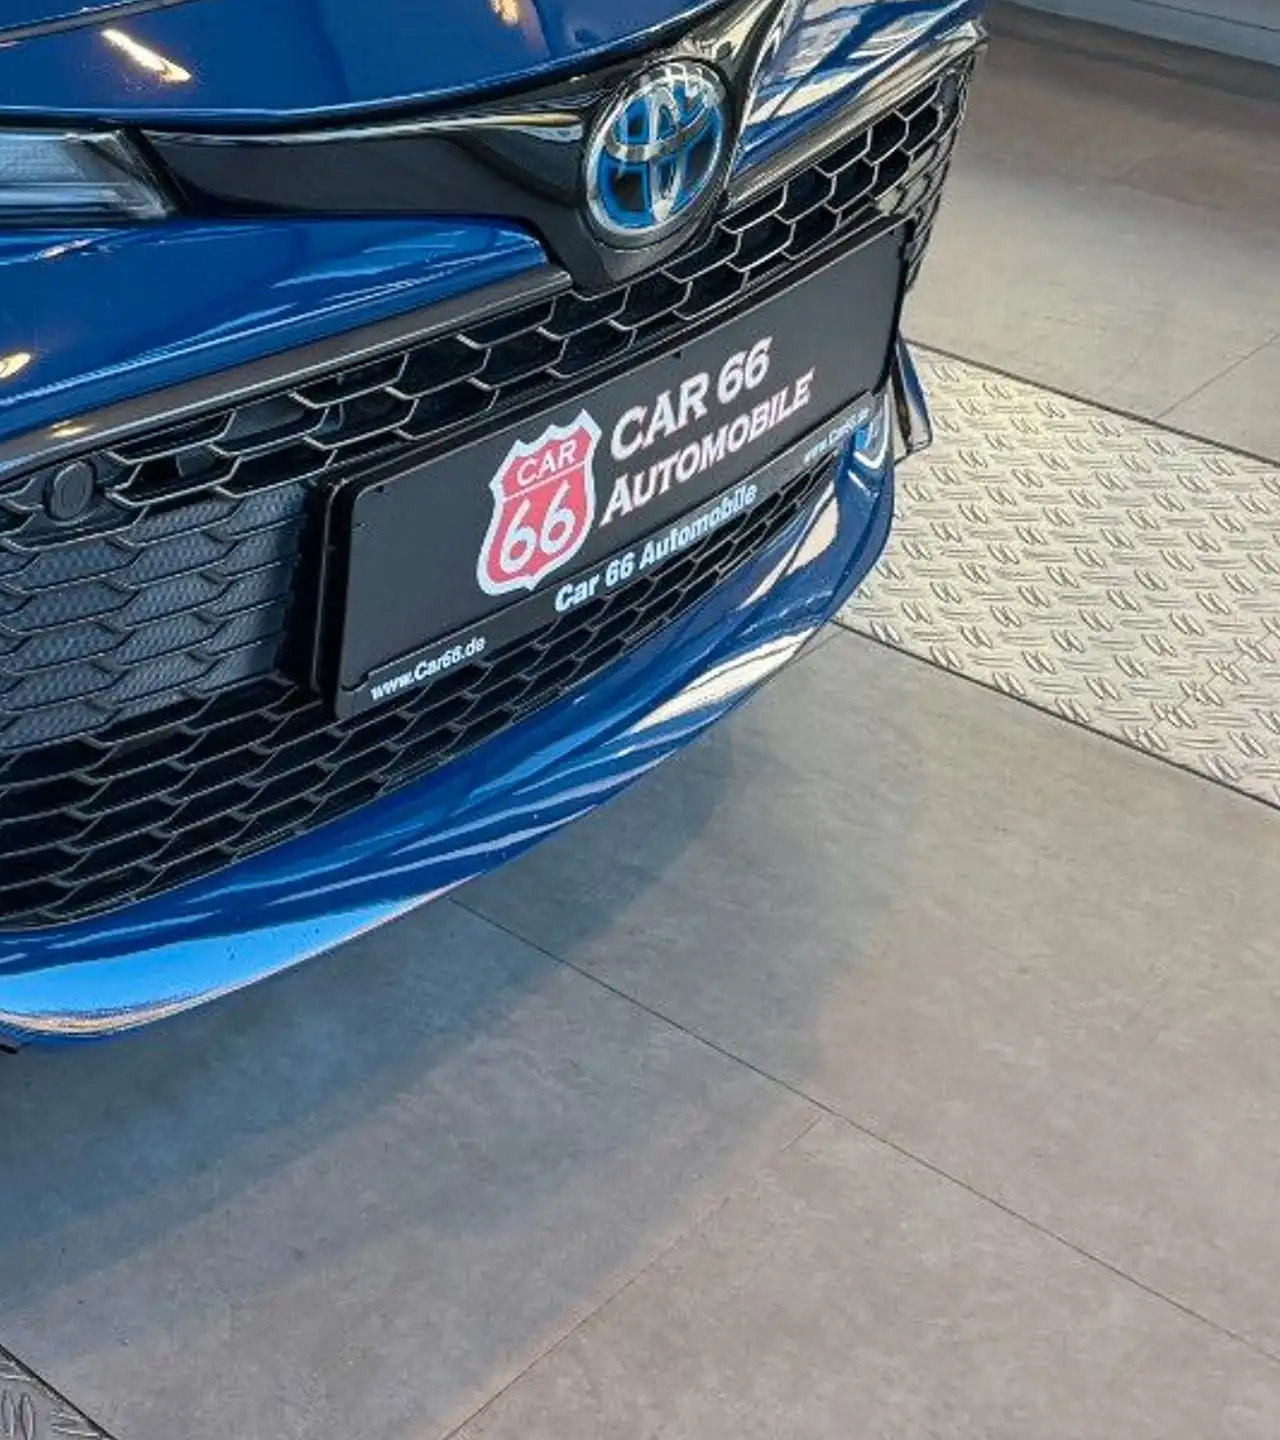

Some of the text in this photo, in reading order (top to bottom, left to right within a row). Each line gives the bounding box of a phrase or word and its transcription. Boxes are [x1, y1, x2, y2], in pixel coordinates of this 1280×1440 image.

[599, 366, 816, 528] AUTOMOBILE
[610, 336, 773, 461] CAR 66
[516, 439, 577, 486] CAR
[499, 480, 577, 575] 66
[554, 483, 759, 613] Car 66 Automobile
[370, 636, 487, 702] www.Car66.de
